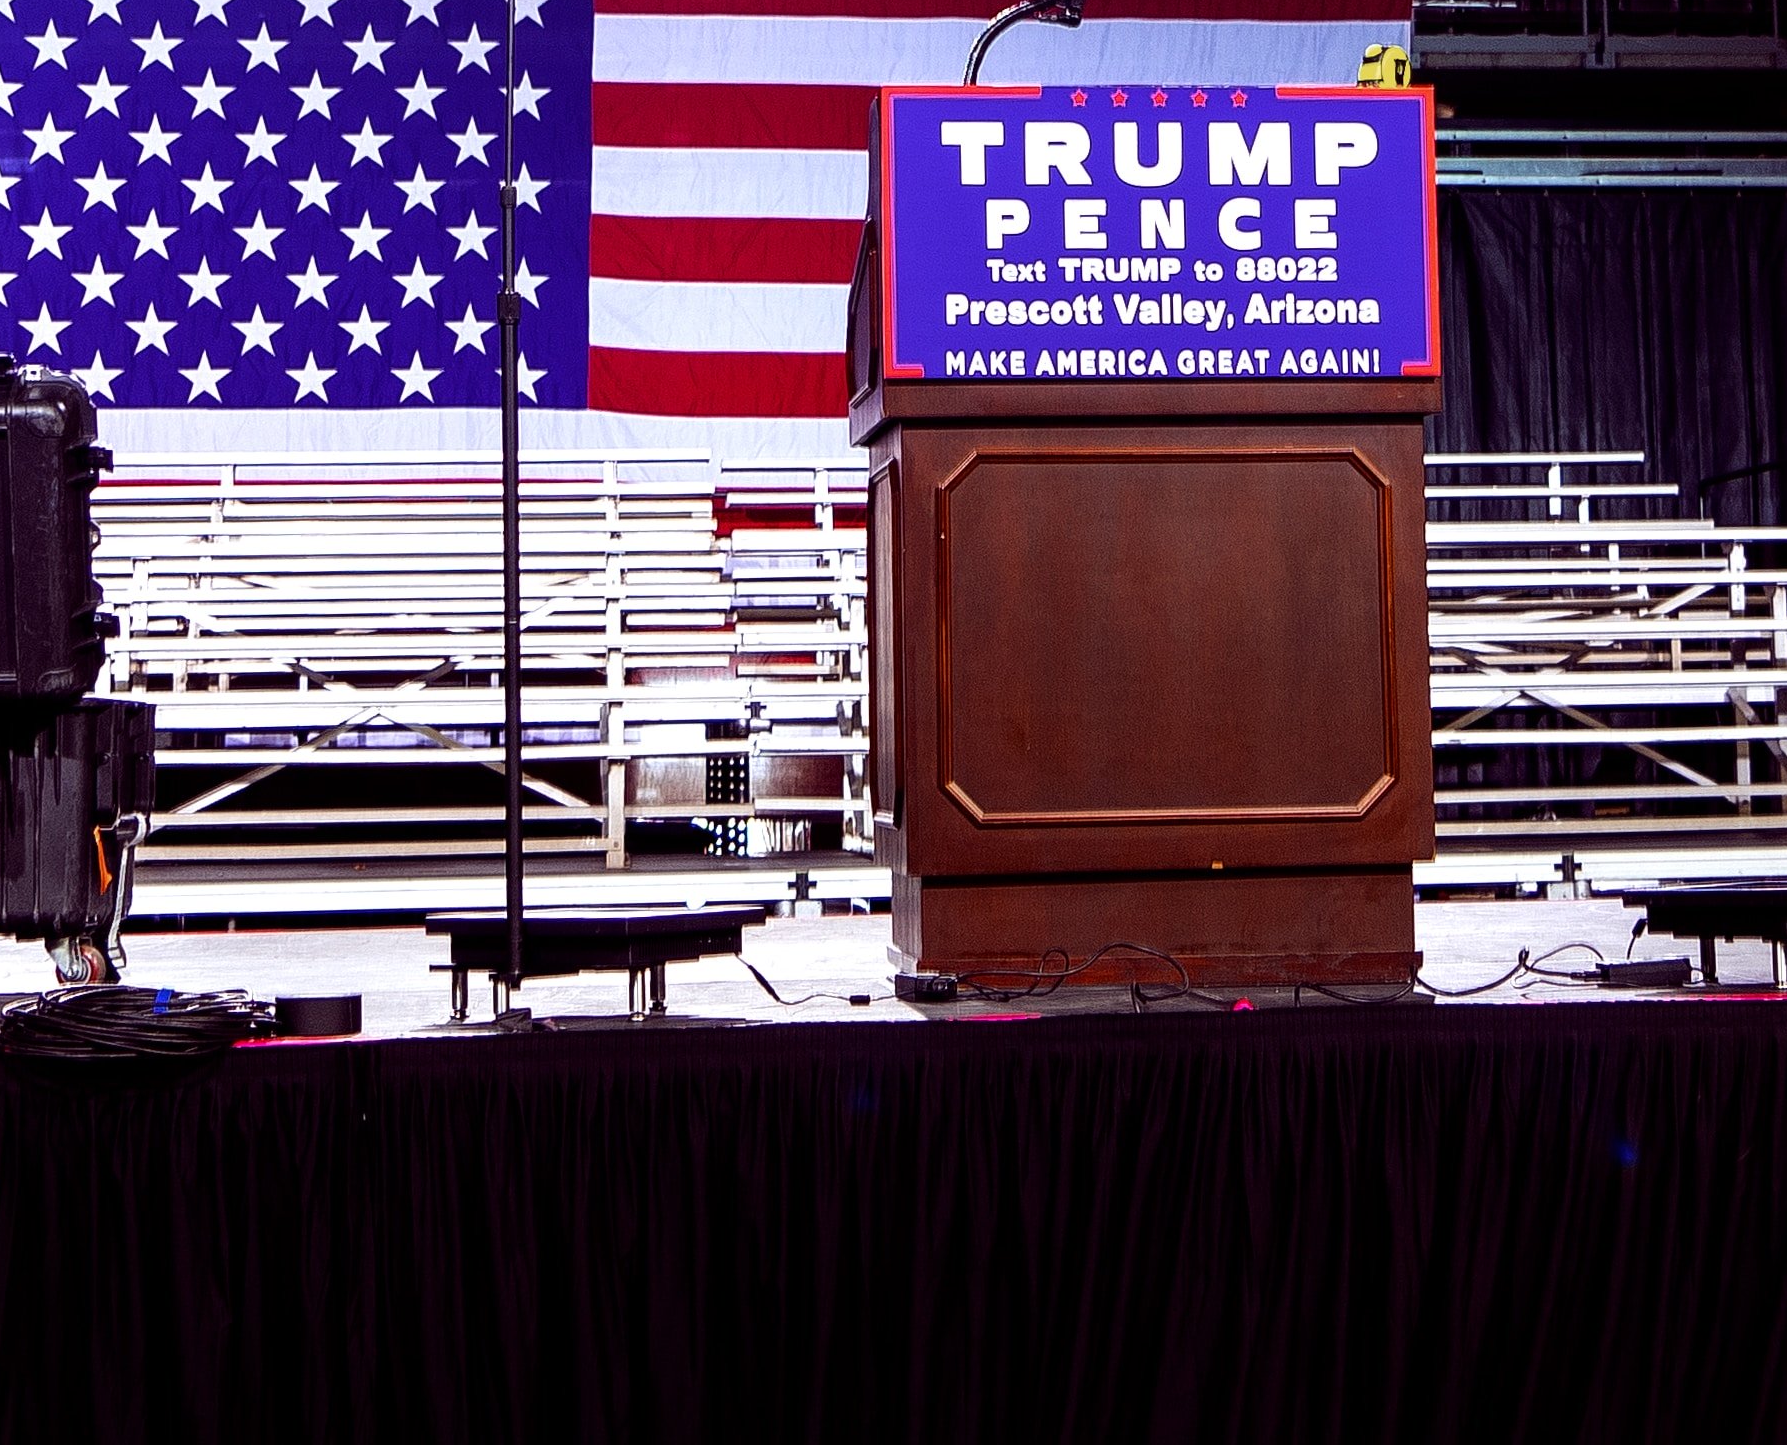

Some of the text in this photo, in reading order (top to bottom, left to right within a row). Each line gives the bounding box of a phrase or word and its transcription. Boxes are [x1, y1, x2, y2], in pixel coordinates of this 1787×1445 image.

[941, 121, 1378, 187] TRUMP
[986, 197, 1337, 251] PENCE
[986, 257, 1338, 282] Text TRUMP to 88022
[946, 293, 1380, 331] Prescott Valley, Arizona
[946, 349, 1380, 376] MAKE AMERICA GREAT AGAIN!
